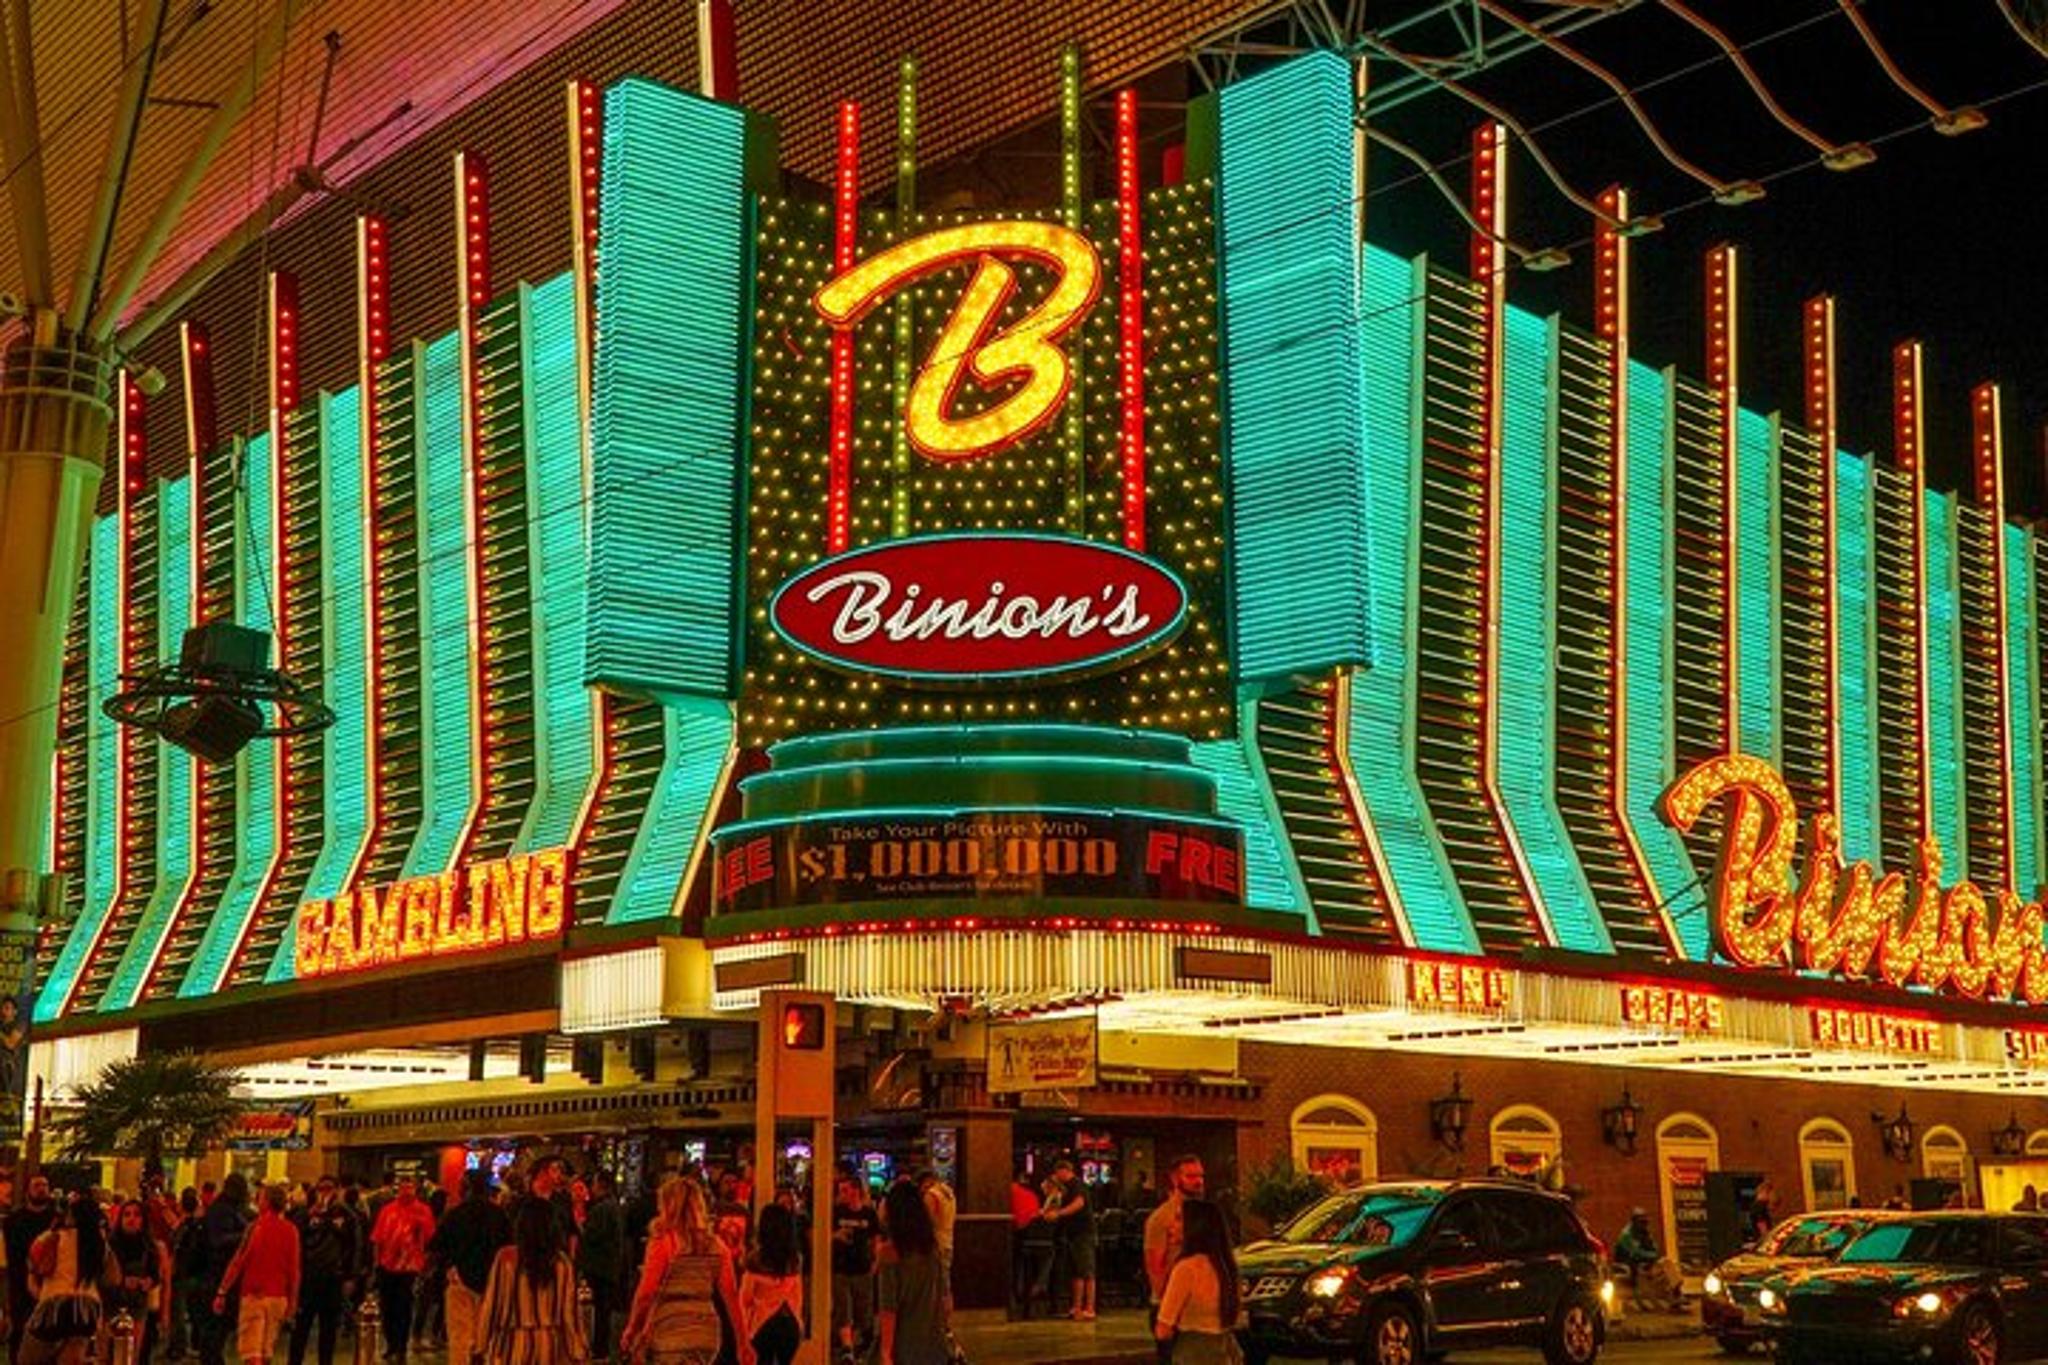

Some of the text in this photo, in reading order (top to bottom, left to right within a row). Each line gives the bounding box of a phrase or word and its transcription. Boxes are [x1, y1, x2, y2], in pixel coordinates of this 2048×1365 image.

[814, 219, 1101, 459] B
[807, 571, 1150, 644] Binion's
[831, 821, 1088, 841] Take Your Picture With
[716, 836, 773, 897] EE
[800, 839, 1117, 884] $1,000,000
[295, 848, 567, 978] GAMBLING
[1415, 961, 1514, 1005] KENO
[1628, 987, 1725, 1028] CRAPS
[1817, 1009, 1942, 1051] ROULETTE
